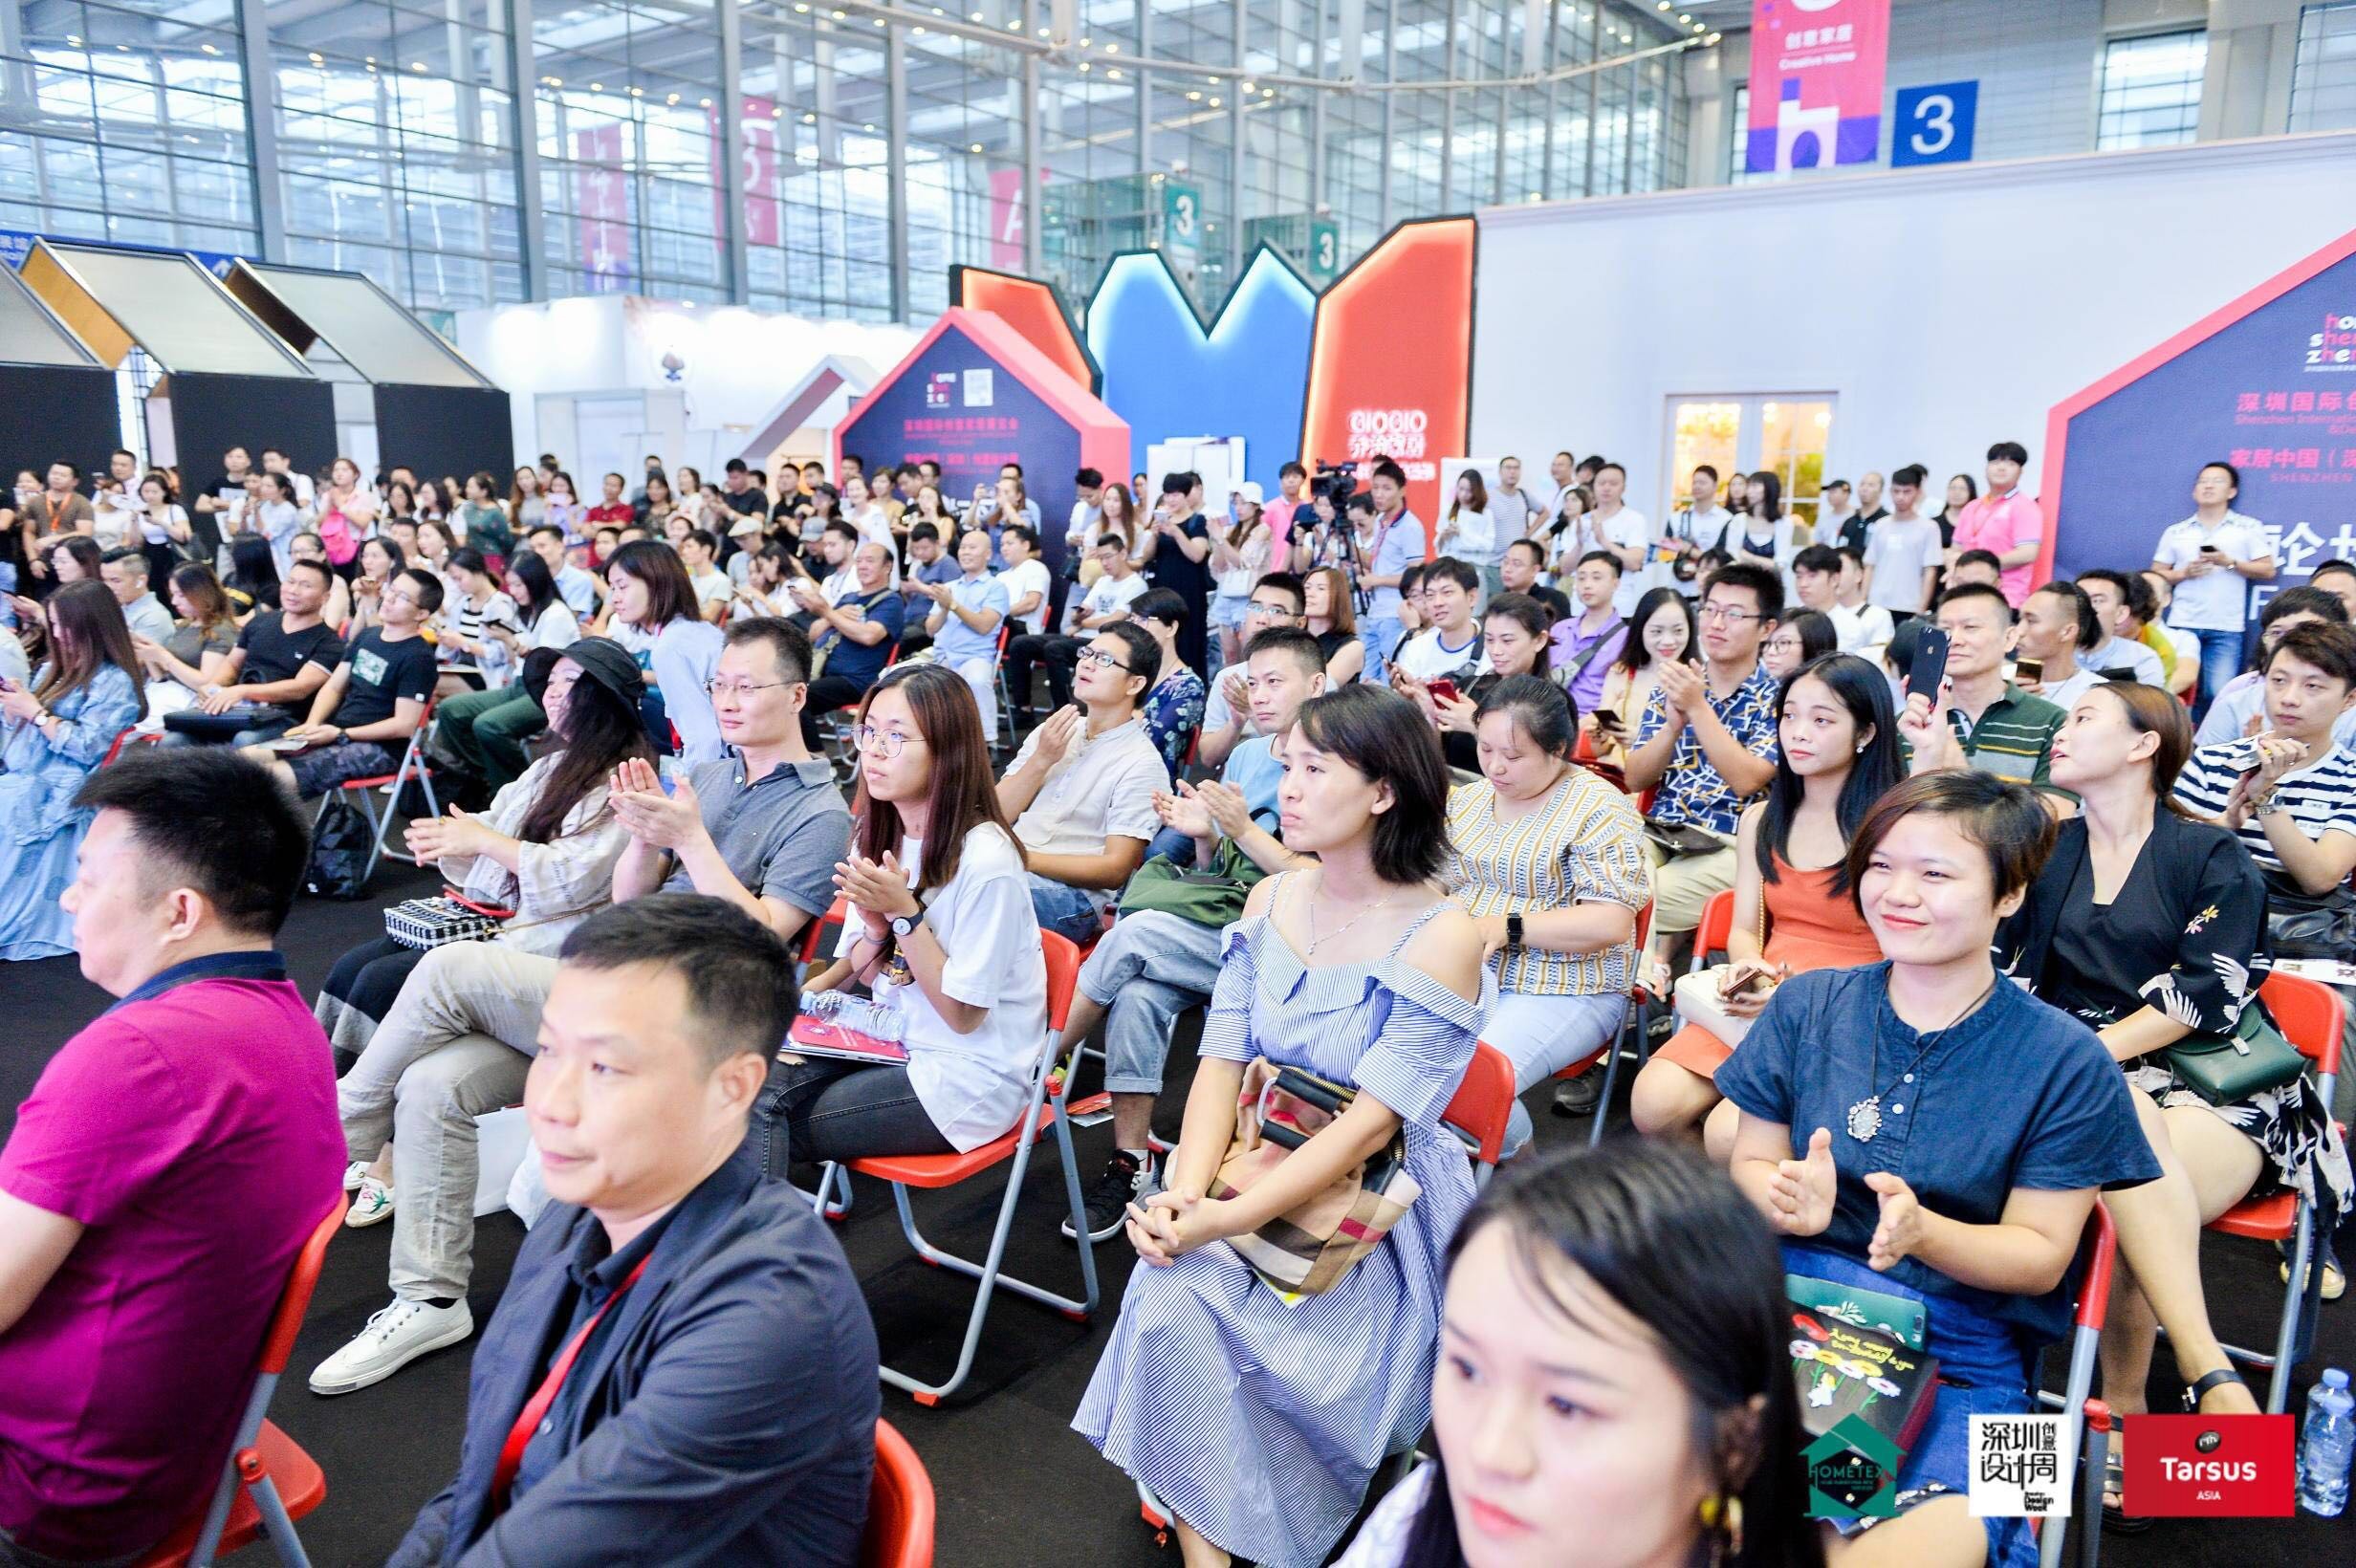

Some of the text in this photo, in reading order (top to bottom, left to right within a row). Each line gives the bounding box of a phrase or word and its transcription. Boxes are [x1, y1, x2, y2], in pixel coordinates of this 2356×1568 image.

[1823, 52, 1857, 64] Home
[1910, 94, 1955, 156] 3
[1176, 195, 1194, 237] 3
[1319, 231, 1335, 270] 3
[2325, 313, 2356, 330] ho
[2263, 521, 2356, 576] 论
